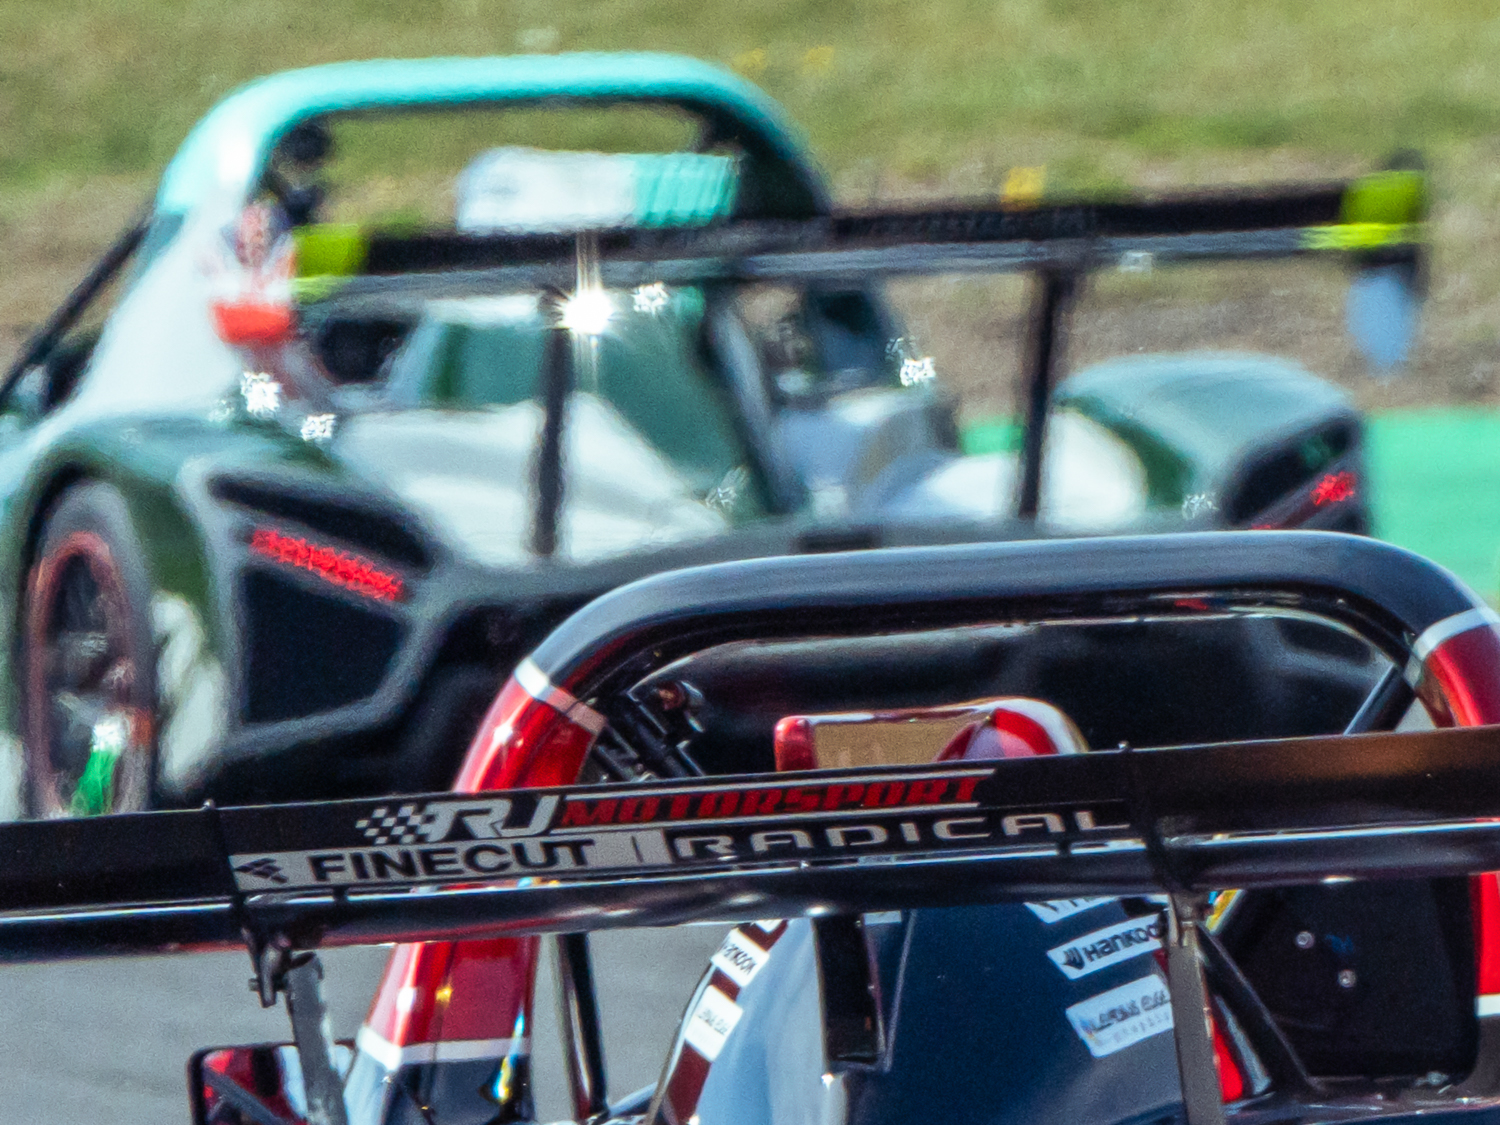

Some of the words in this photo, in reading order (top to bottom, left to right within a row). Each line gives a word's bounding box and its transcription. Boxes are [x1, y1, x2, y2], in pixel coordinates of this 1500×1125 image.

[426, 795, 561, 842] RJ
[563, 777, 982, 826] MOTORSPORT
[308, 839, 594, 881] FINECUT
[673, 811, 1130, 858] RADICAL
